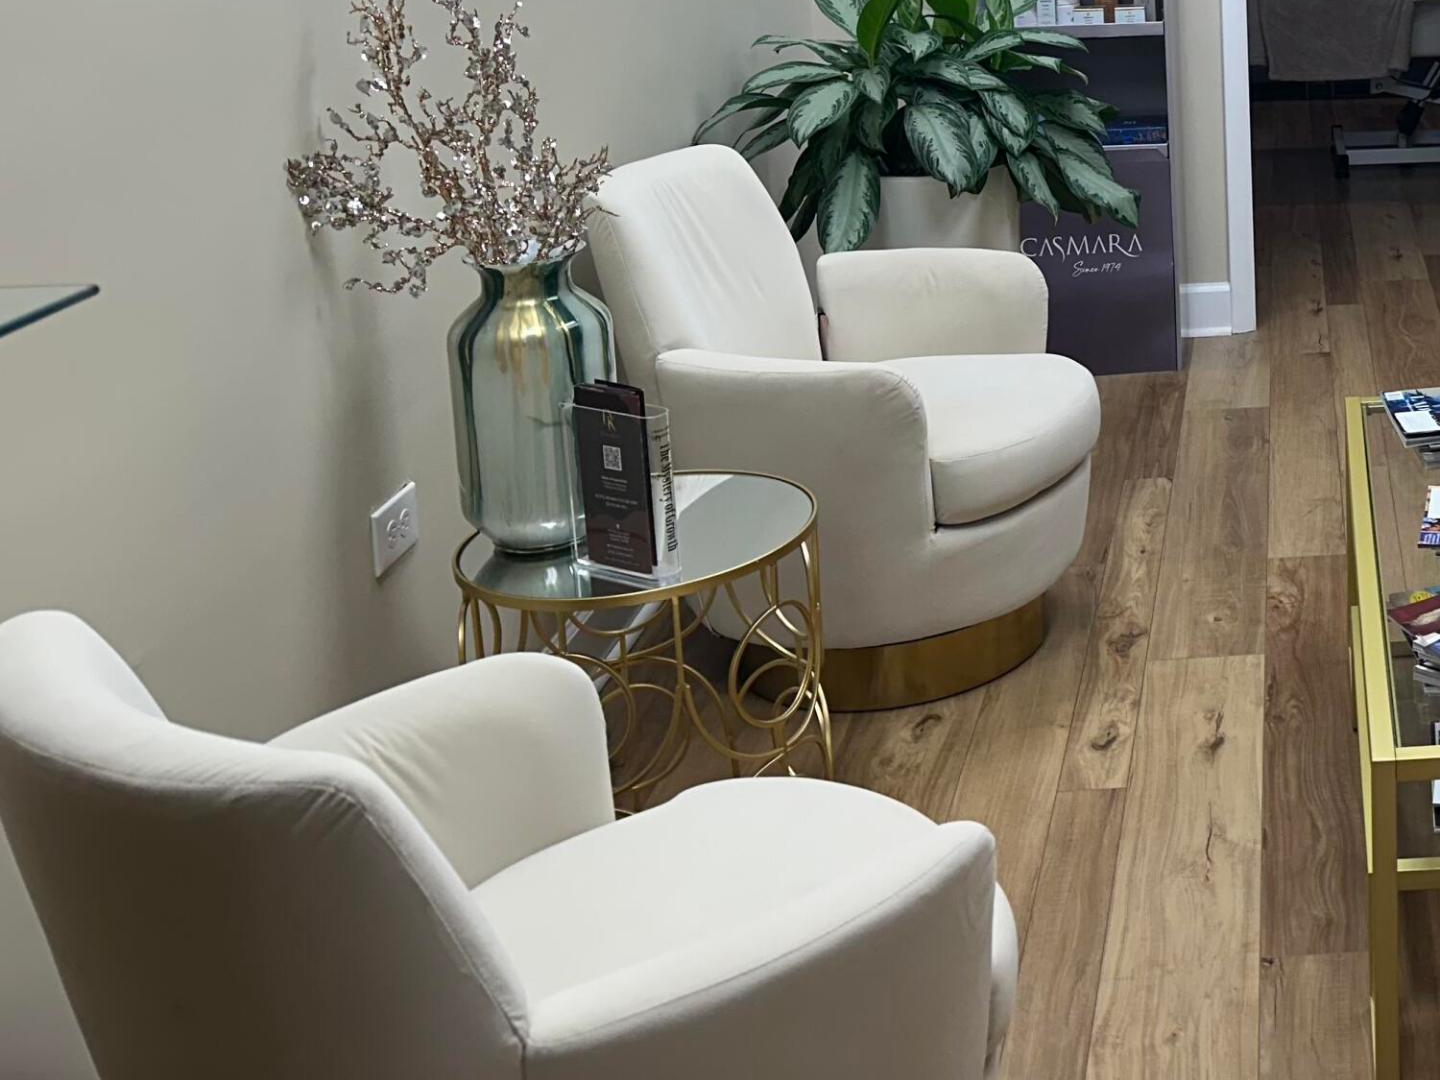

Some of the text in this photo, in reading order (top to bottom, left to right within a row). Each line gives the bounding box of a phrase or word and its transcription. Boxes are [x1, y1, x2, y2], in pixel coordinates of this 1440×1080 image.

[1019, 233, 1144, 264] CASMARA
[1071, 260, 1123, 278] Since 1974
